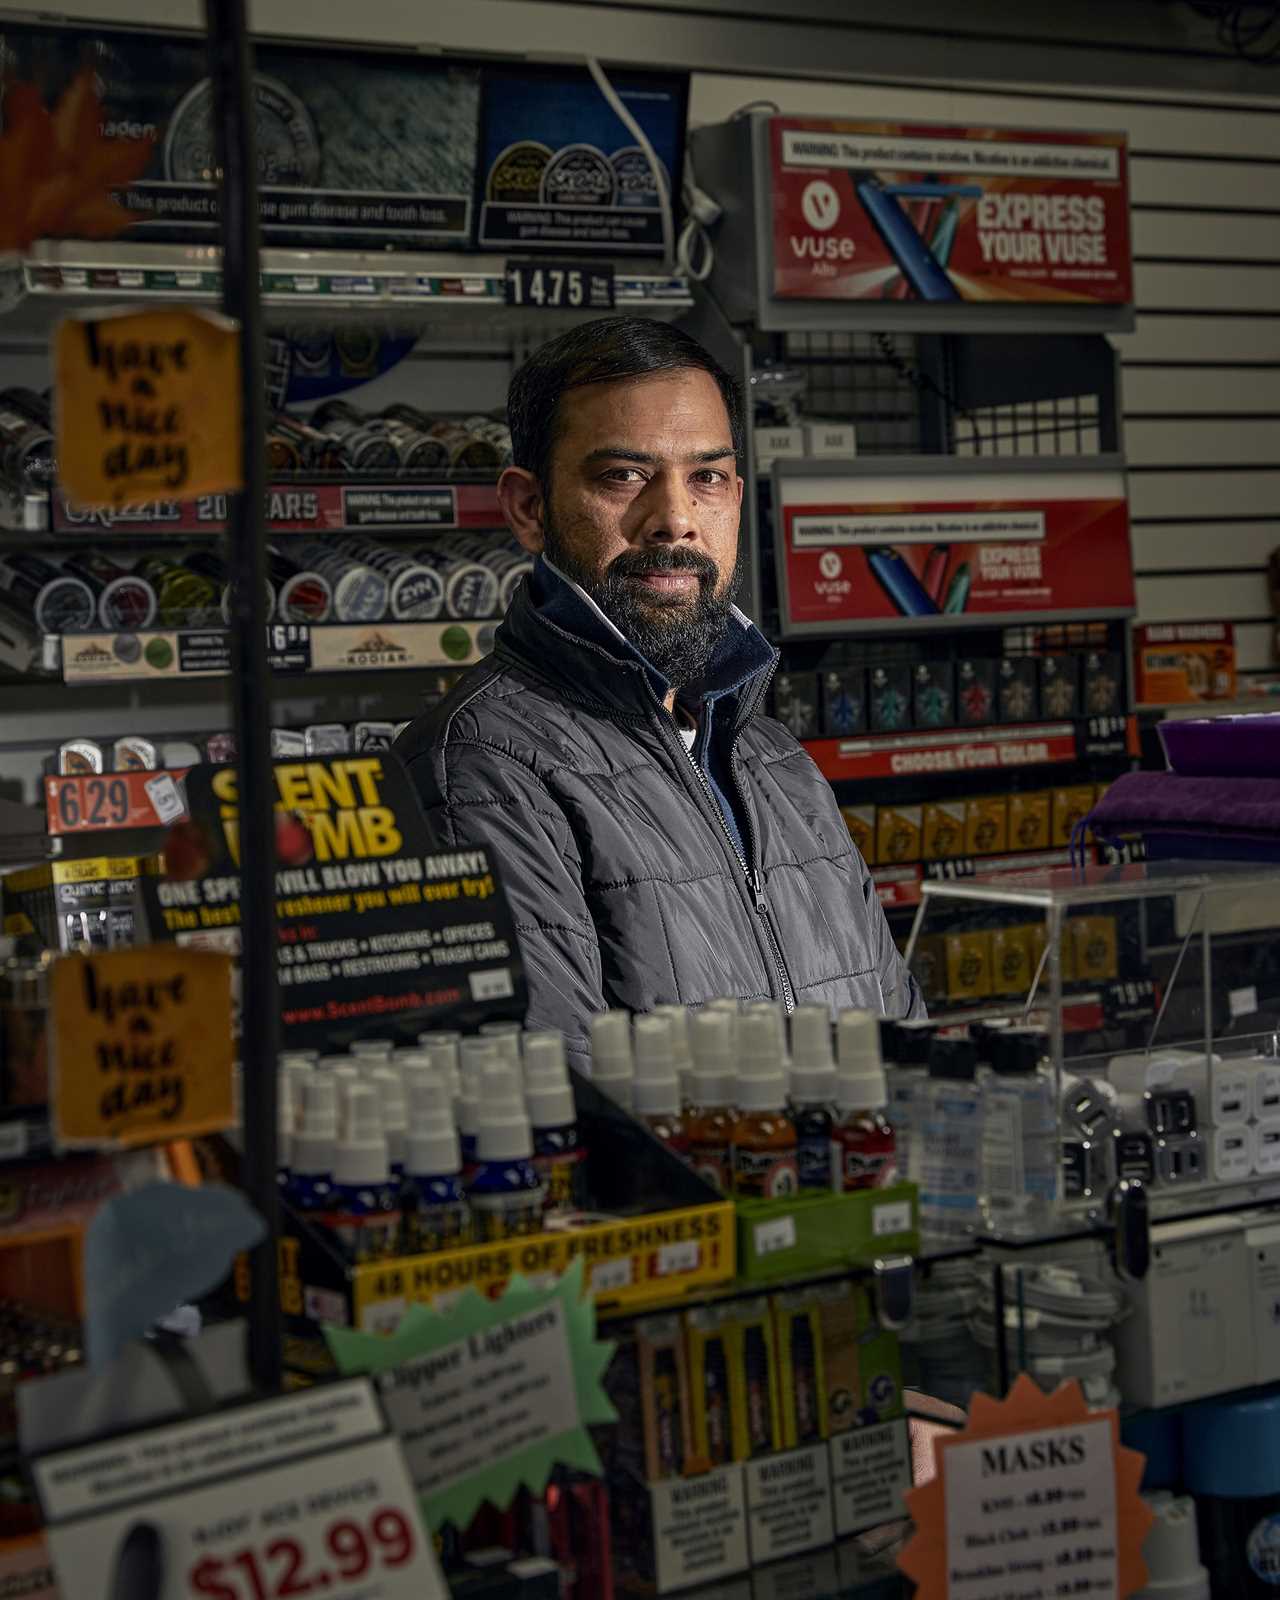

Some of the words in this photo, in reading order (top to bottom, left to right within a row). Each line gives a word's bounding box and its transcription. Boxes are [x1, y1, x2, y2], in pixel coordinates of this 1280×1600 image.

[976, 193, 1106, 232] EXPRESS
[977, 231, 1045, 264] YOUR
[1045, 233, 1108, 265] VUSE
[85, 321, 188, 384] have
[132, 379, 157, 400] a
[99, 396, 179, 435] nice
[104, 444, 189, 490] day
[157, 880, 201, 907] ONE
[322, 863, 380, 891] BLOW
[381, 858, 424, 884] YOU
[425, 850, 489, 877] AWAY!
[388, 883, 421, 905] will
[82, 960, 189, 1025] have
[127, 1014, 154, 1035] a
[96, 1041, 177, 1073] nice
[99, 1077, 189, 1122] day
[413, 1249, 511, 1288] HOURS
[521, 1241, 557, 1268] OF
[568, 1213, 722, 1258] FRESHNESS
[982, 1436, 1086, 1477] MASKS
[191, 1506, 415, 1600] $12.99
